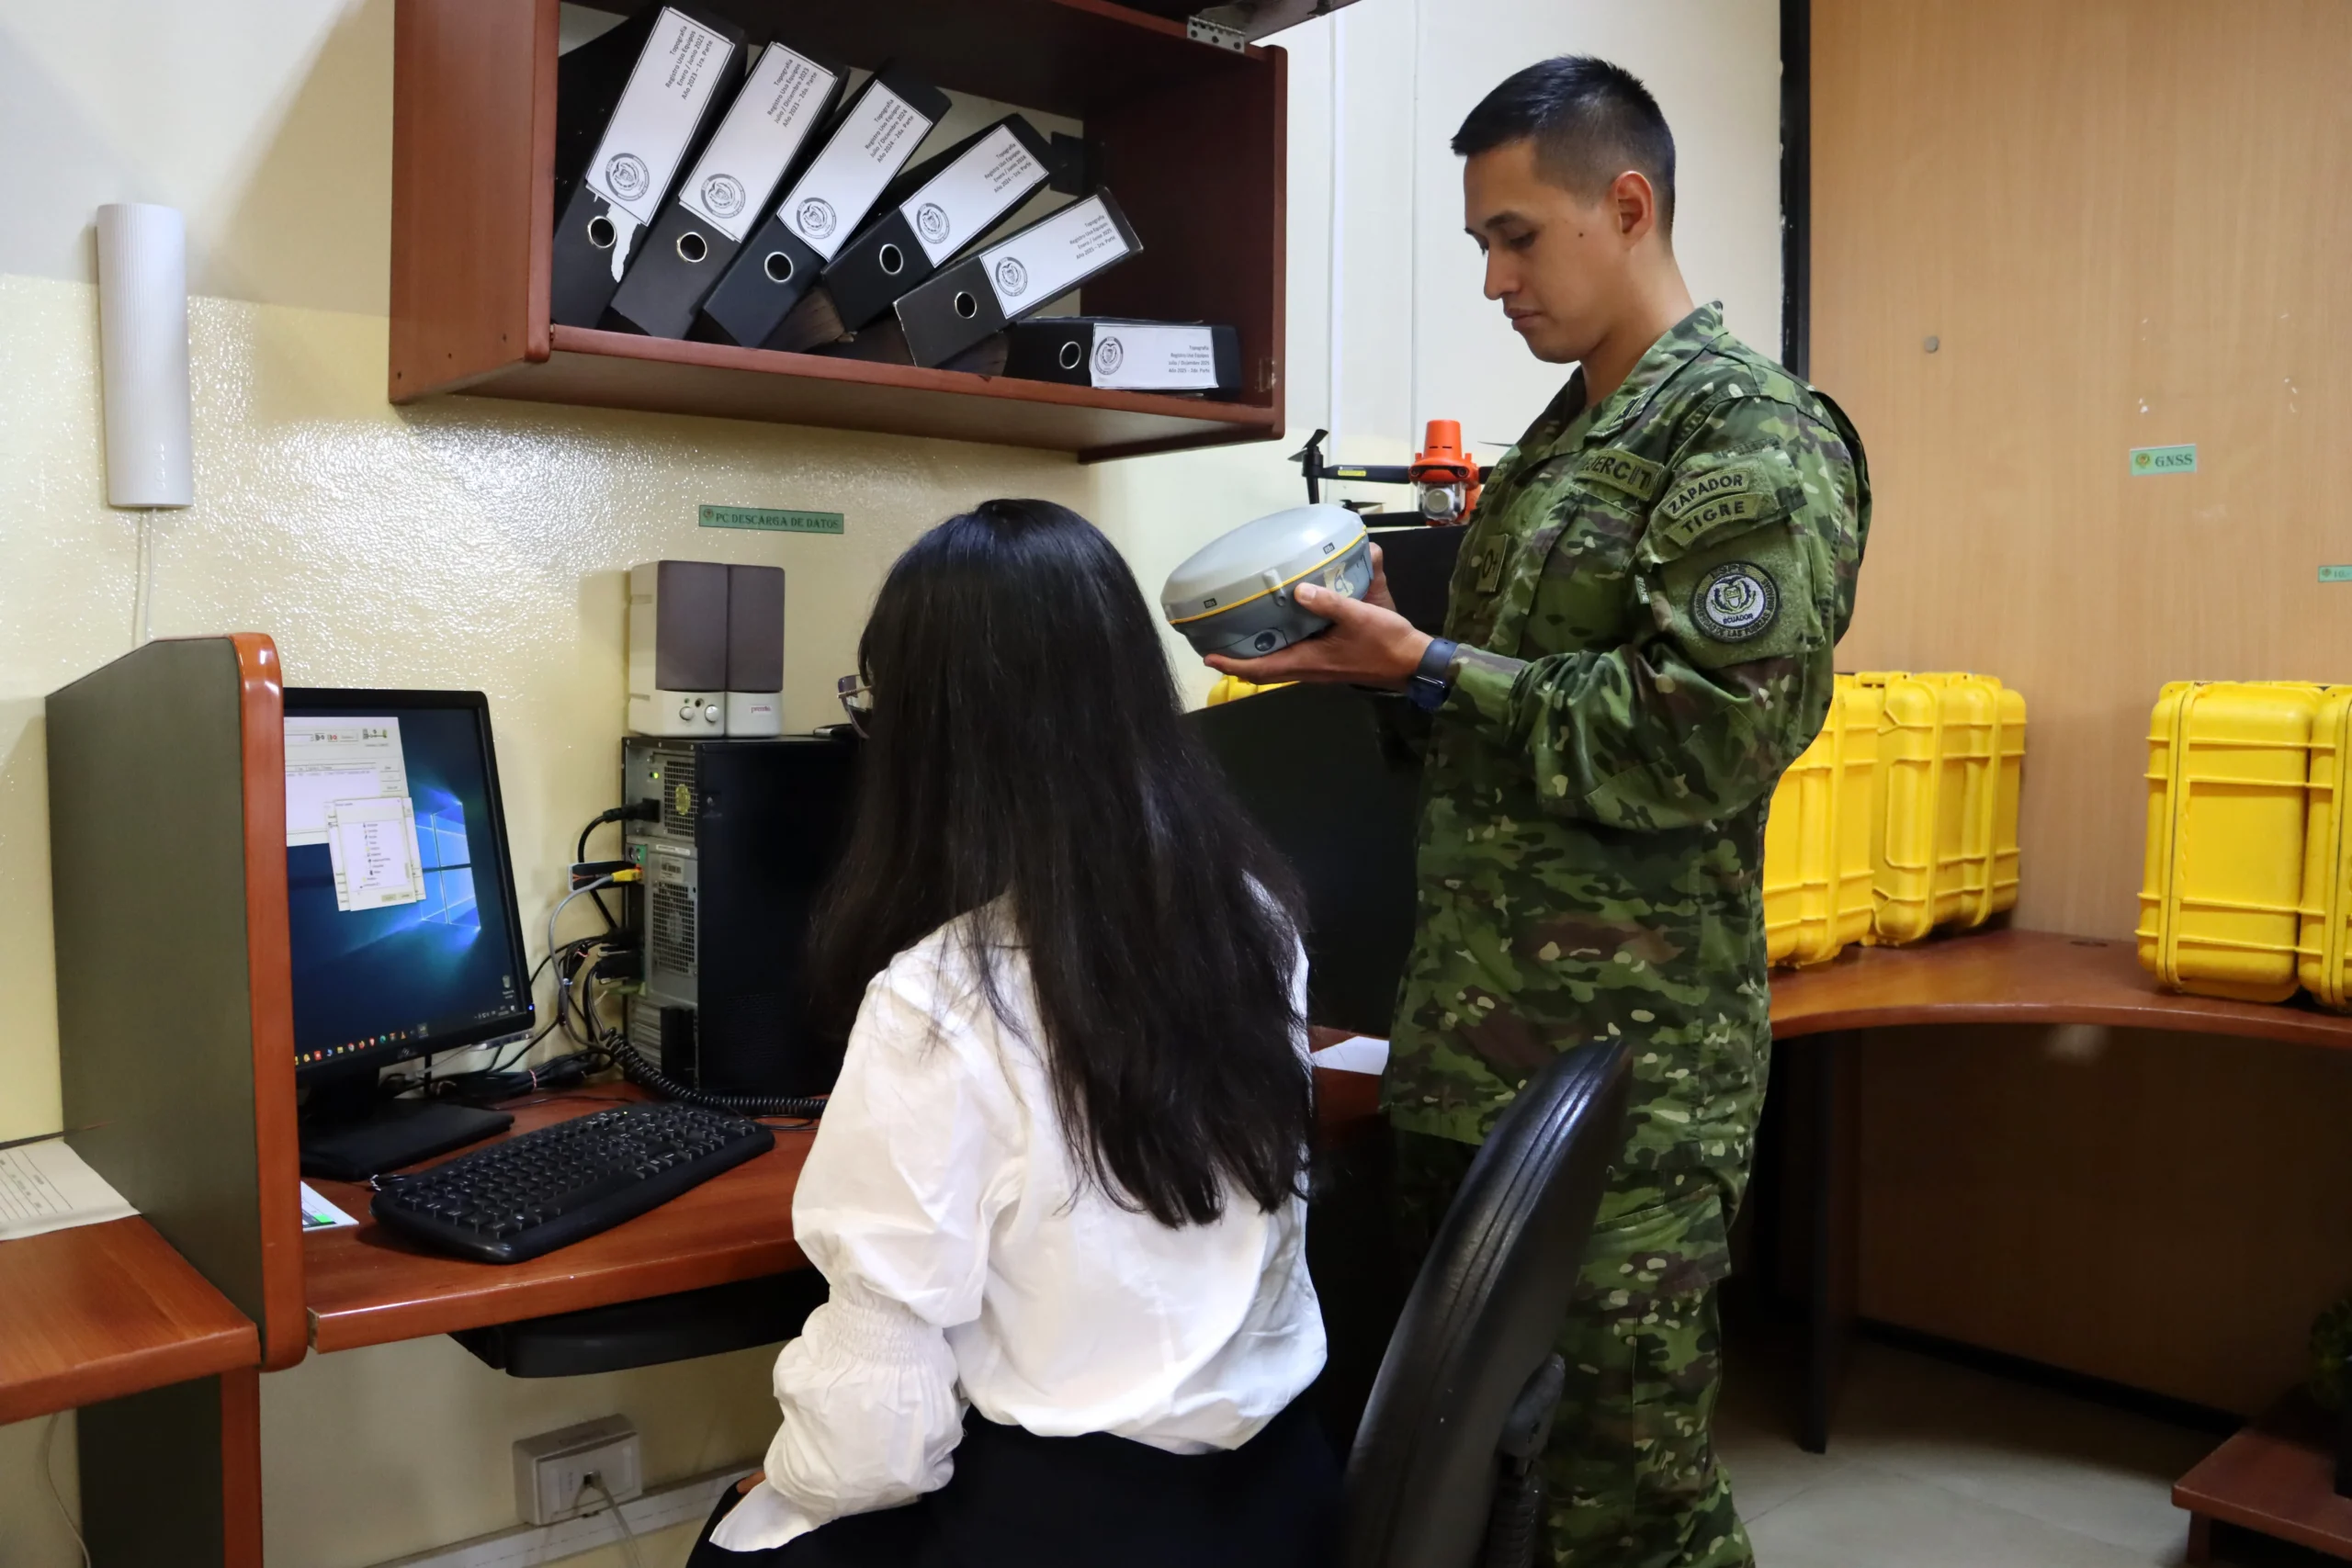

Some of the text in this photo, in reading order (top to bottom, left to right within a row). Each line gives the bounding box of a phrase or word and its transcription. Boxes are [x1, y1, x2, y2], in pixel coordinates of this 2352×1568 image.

[664, 30, 695, 87] Registro Uso Equipos
[669, 26, 687, 54] Topografía
[676, 69, 688, 85] Enero
[686, 49, 697, 65] Junio
[694, 34, 704, 49] 2023
[681, 87, 690, 99] Año
[686, 72, 697, 87] 2023
[696, 57, 705, 67] 1ra.
[701, 40, 712, 55] Parte
[766, 63, 800, 115] Registro Uso Equipos
[774, 110, 784, 123] Julio
[783, 81, 801, 107] Diciembre
[798, 67, 808, 80] 2023
[782, 116, 791, 127] Año
[788, 102, 799, 116] 2023
[798, 87, 808, 98] 2da.
[806, 72, 817, 85] Parte
[865, 105, 900, 149] Registro Uso Equipos
[870, 146, 879, 157] Julio
[879, 120, 899, 143] Diciembre
[897, 108, 907, 121] 2024
[876, 152, 886, 163] Año
[884, 141, 894, 152] 2024
[894, 129, 903, 138] 2da.
[902, 115, 913, 128] Parte
[2154, 453, 2193, 468] GNSS
[1668, 474, 1743, 513] ZAPADOR
[1682, 501, 1745, 534] TIGRE
[716, 512, 840, 529] PC DESCARGA DE DATOS
[1723, 613, 1753, 625] ECUADOR
